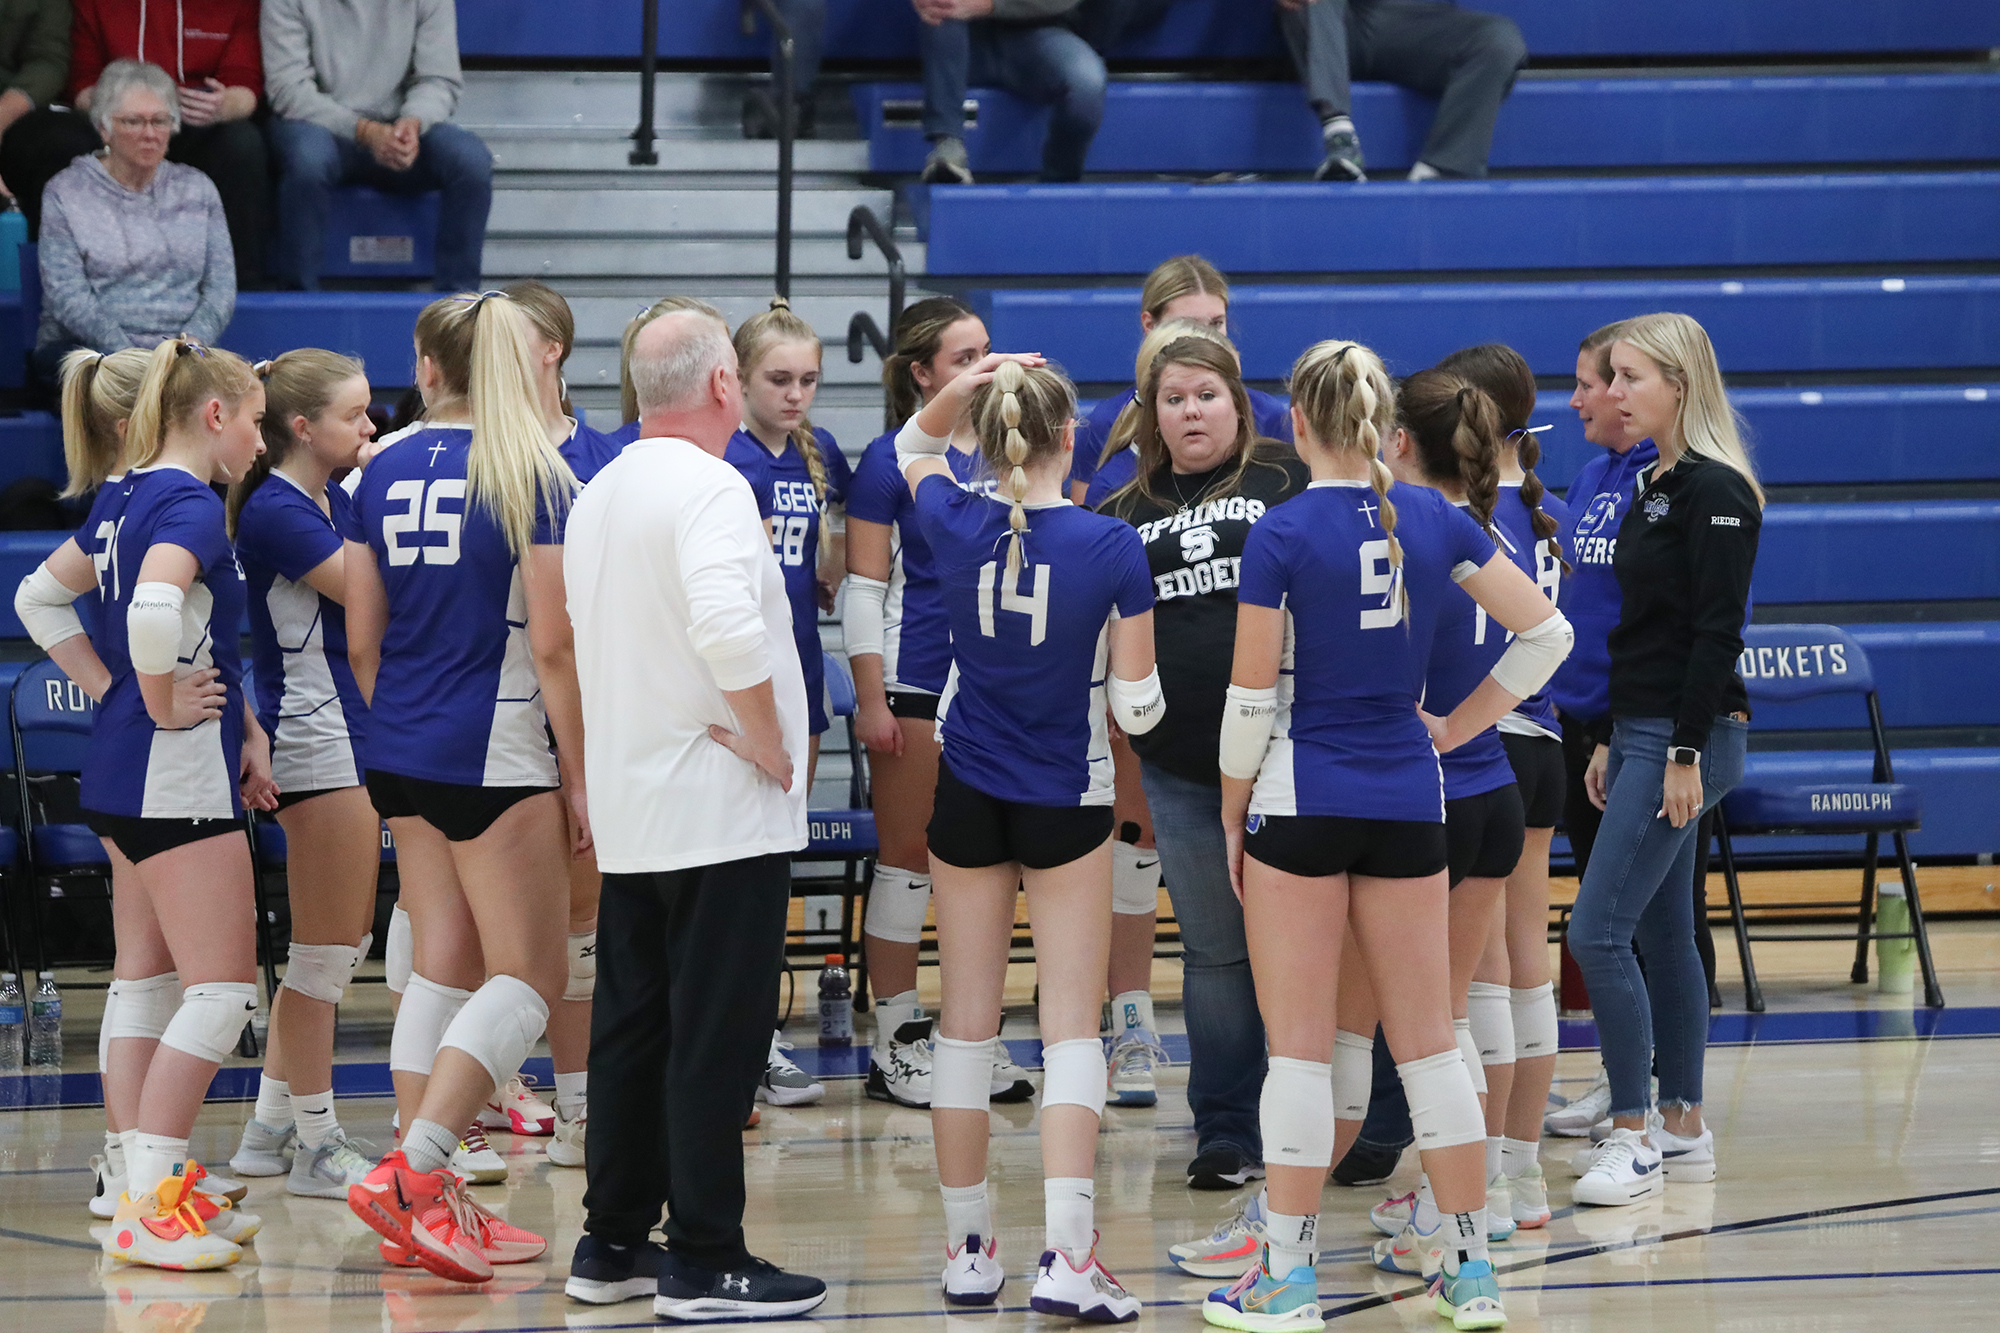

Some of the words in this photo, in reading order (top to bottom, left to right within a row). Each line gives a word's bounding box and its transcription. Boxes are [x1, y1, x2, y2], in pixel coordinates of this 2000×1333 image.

[773, 480, 820, 513] GER
[382, 478, 467, 567] 25
[1137, 496, 1266, 546] SPRINGS
[1710, 515, 1741, 527] RIEDER
[91, 515, 126, 603] 21
[771, 515, 809, 566] 28
[1179, 525, 1220, 563] S
[1573, 536, 1617, 565] GERS
[1358, 538, 1405, 630] 9
[977, 560, 1051, 647] 14
[1740, 643, 1848, 678] OCKETS
[1811, 793, 1892, 812] RANDOLPH
[810, 822, 852, 840] OLPH
